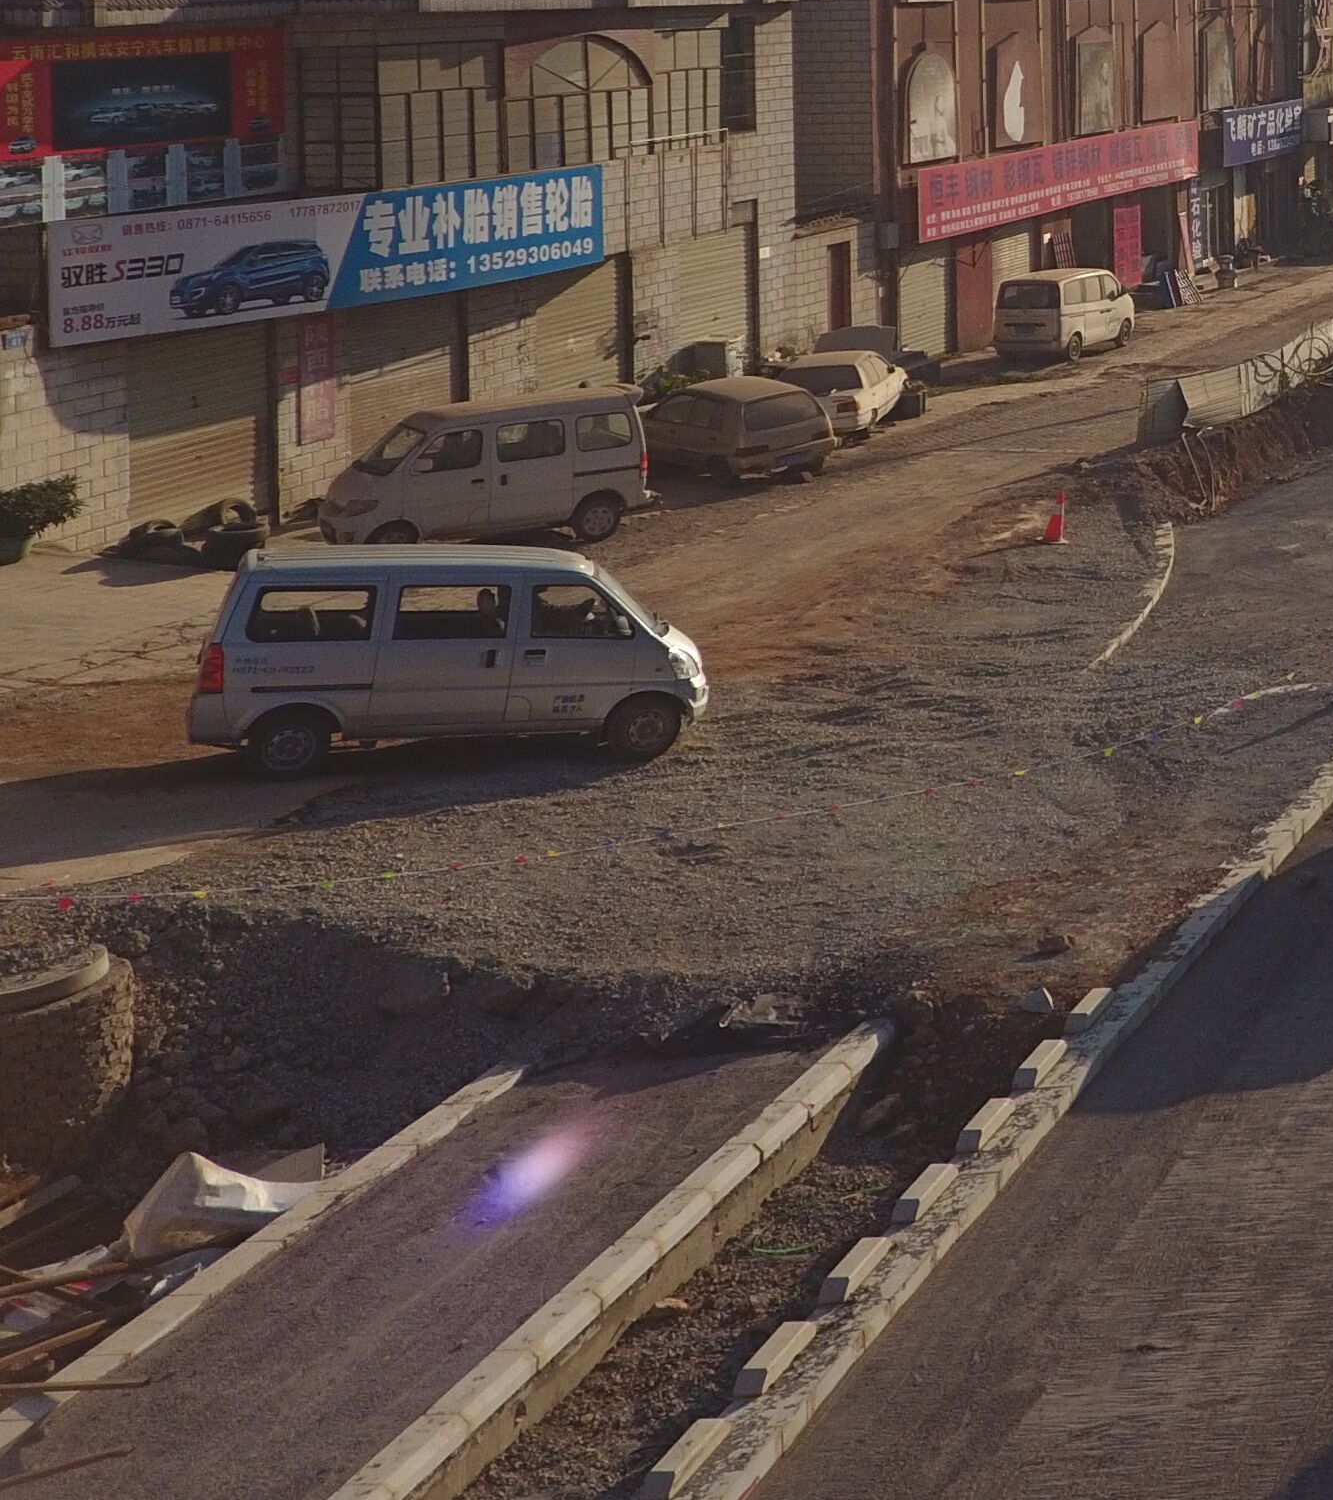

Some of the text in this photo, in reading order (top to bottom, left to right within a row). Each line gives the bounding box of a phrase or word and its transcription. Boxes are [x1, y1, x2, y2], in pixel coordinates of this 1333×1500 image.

[289, 200, 361, 218] 17787872017
[362, 176, 594, 258] 专业补胎销售轮胎
[467, 237, 593, 274] 13529306049
